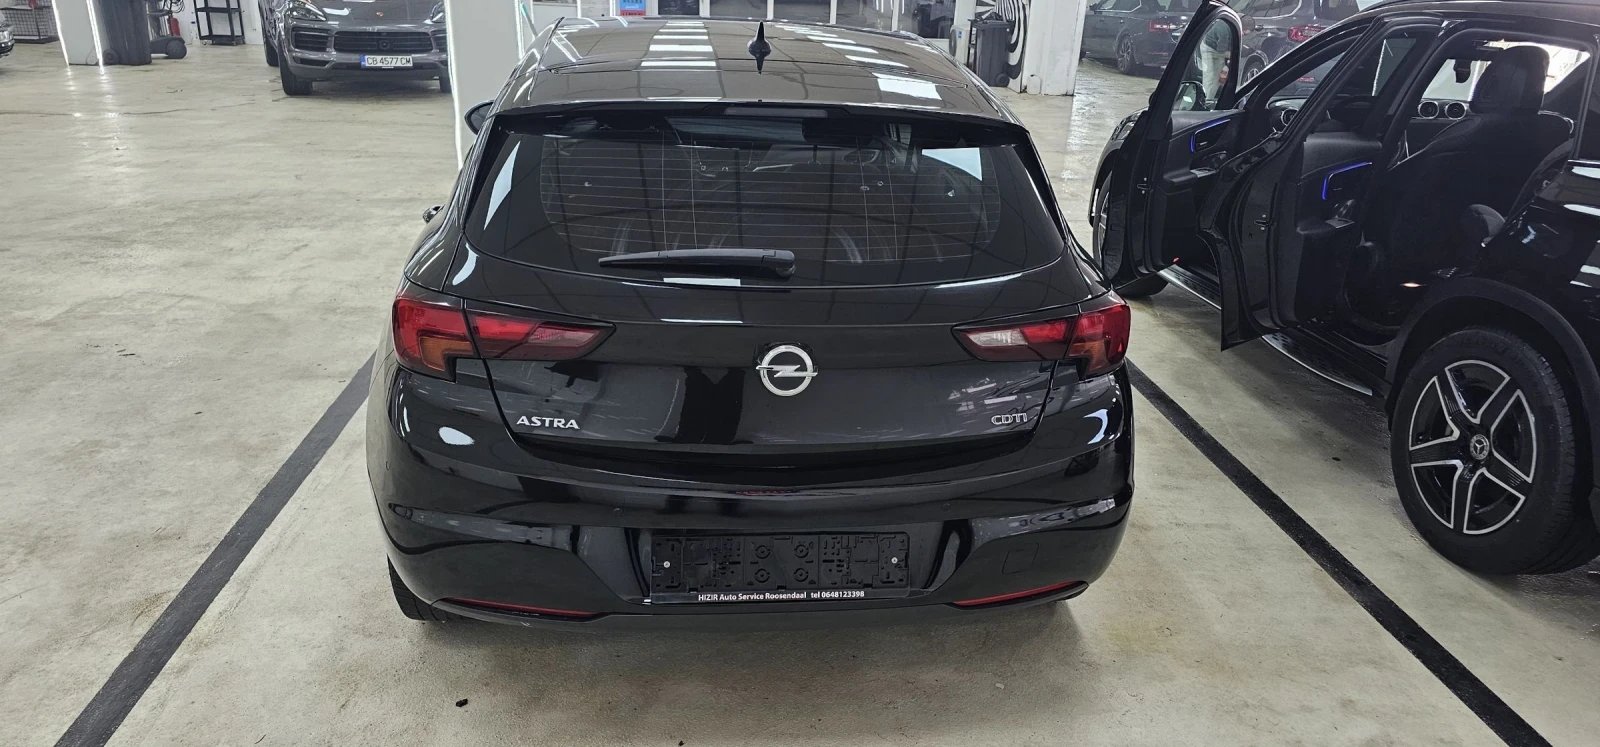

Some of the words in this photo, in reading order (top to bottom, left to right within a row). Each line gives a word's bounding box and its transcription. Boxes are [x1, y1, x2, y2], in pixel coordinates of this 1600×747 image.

[367, 57, 378, 65] CB
[380, 57, 399, 65] 4577
[400, 57, 411, 65] CM
[516, 416, 580, 429] ASTRA
[991, 413, 1027, 424] CDTI
[738, 592, 764, 600] Service
[765, 591, 807, 599] Roosendaal
[811, 591, 820, 599] tel
